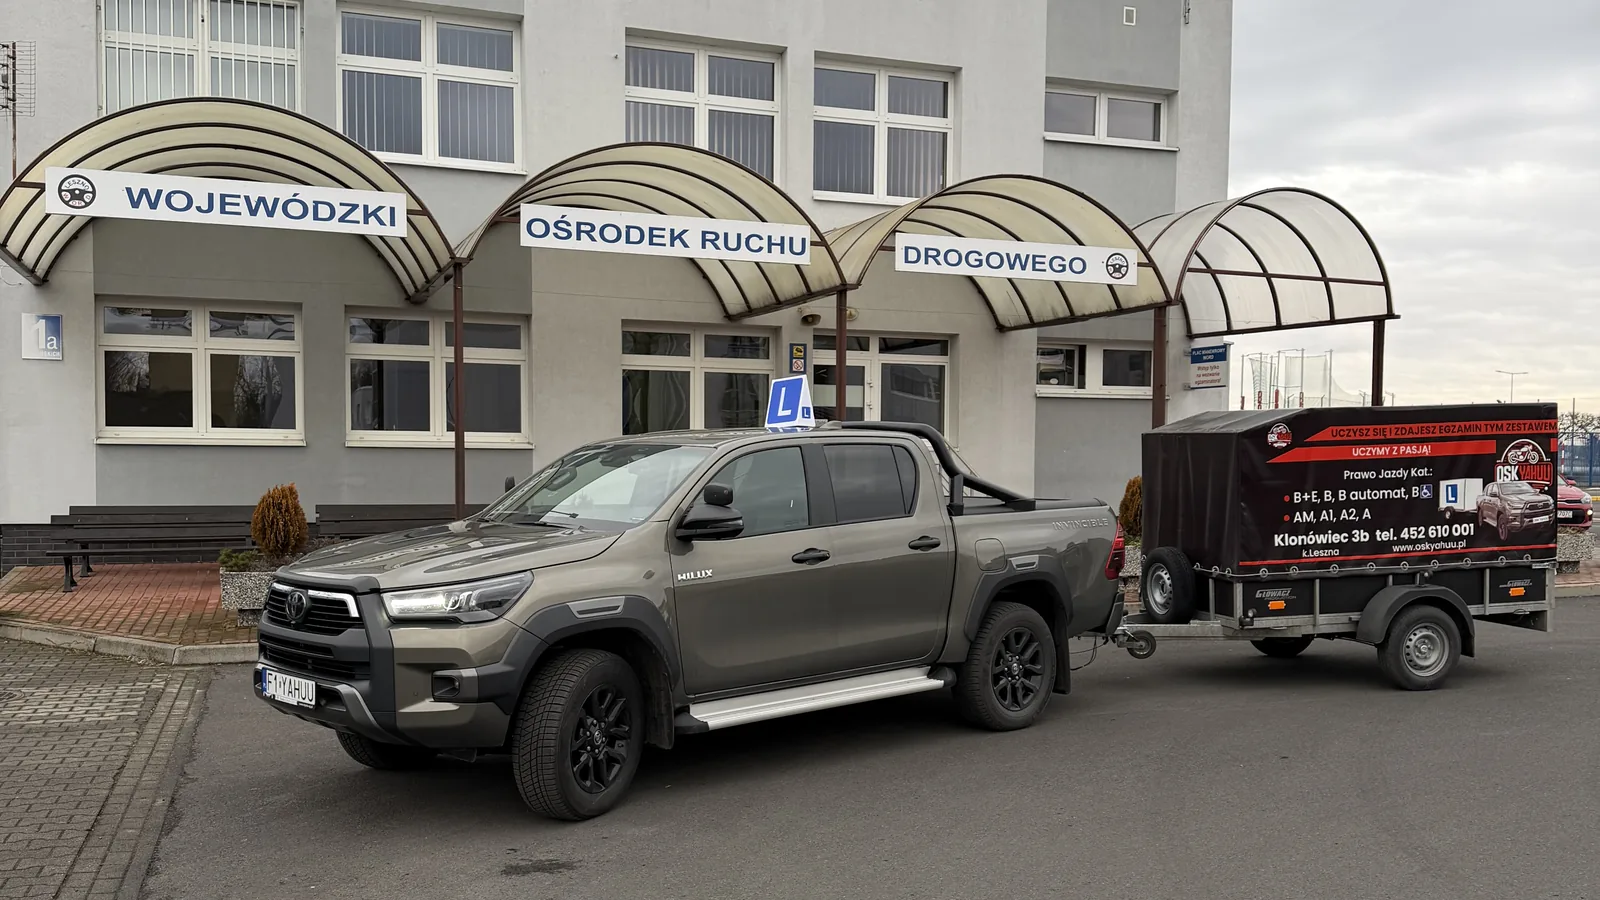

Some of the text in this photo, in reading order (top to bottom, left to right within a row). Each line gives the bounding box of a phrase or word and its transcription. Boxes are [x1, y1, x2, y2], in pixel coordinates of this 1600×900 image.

[65, 179, 90, 191] LESZNO
[125, 187, 396, 227] WOJEWÓDZKI
[526, 214, 807, 256] OŚRODEK RUCHU
[904, 245, 1087, 275] DROGOWEGO
[777, 387, 792, 417] L
[803, 408, 809, 418] L
[1331, 428, 1371, 438] UCZYSZ
[1373, 427, 1387, 438] SIĘ
[1394, 425, 1437, 436] ZDAJESZ
[1438, 424, 1482, 434] EGZAMIN
[1484, 423, 1504, 432] TYM
[1506, 421, 1557, 432] ZESTAWEM
[1352, 445, 1431, 456] UCZYMY Z PASJĄ!
[1344, 467, 1433, 480] Prawo Jazdy Kat.:
[1496, 465, 1550, 482] OSK YAHUU
[1293, 487, 1420, 504] B+E, B, B automat, B
[1448, 484, 1456, 501] L
[1293, 508, 1372, 523] AM, A1, A2, A
[1052, 518, 1109, 531] INVINCIBLE
[1274, 523, 1475, 547] Klonówiec 3b tel. 452 610 001
[1302, 539, 1467, 558] k.Leszna www.oskyahuu.pl
[677, 569, 713, 581] HILUX
[268, 672, 314, 702] F1 YAHUU
